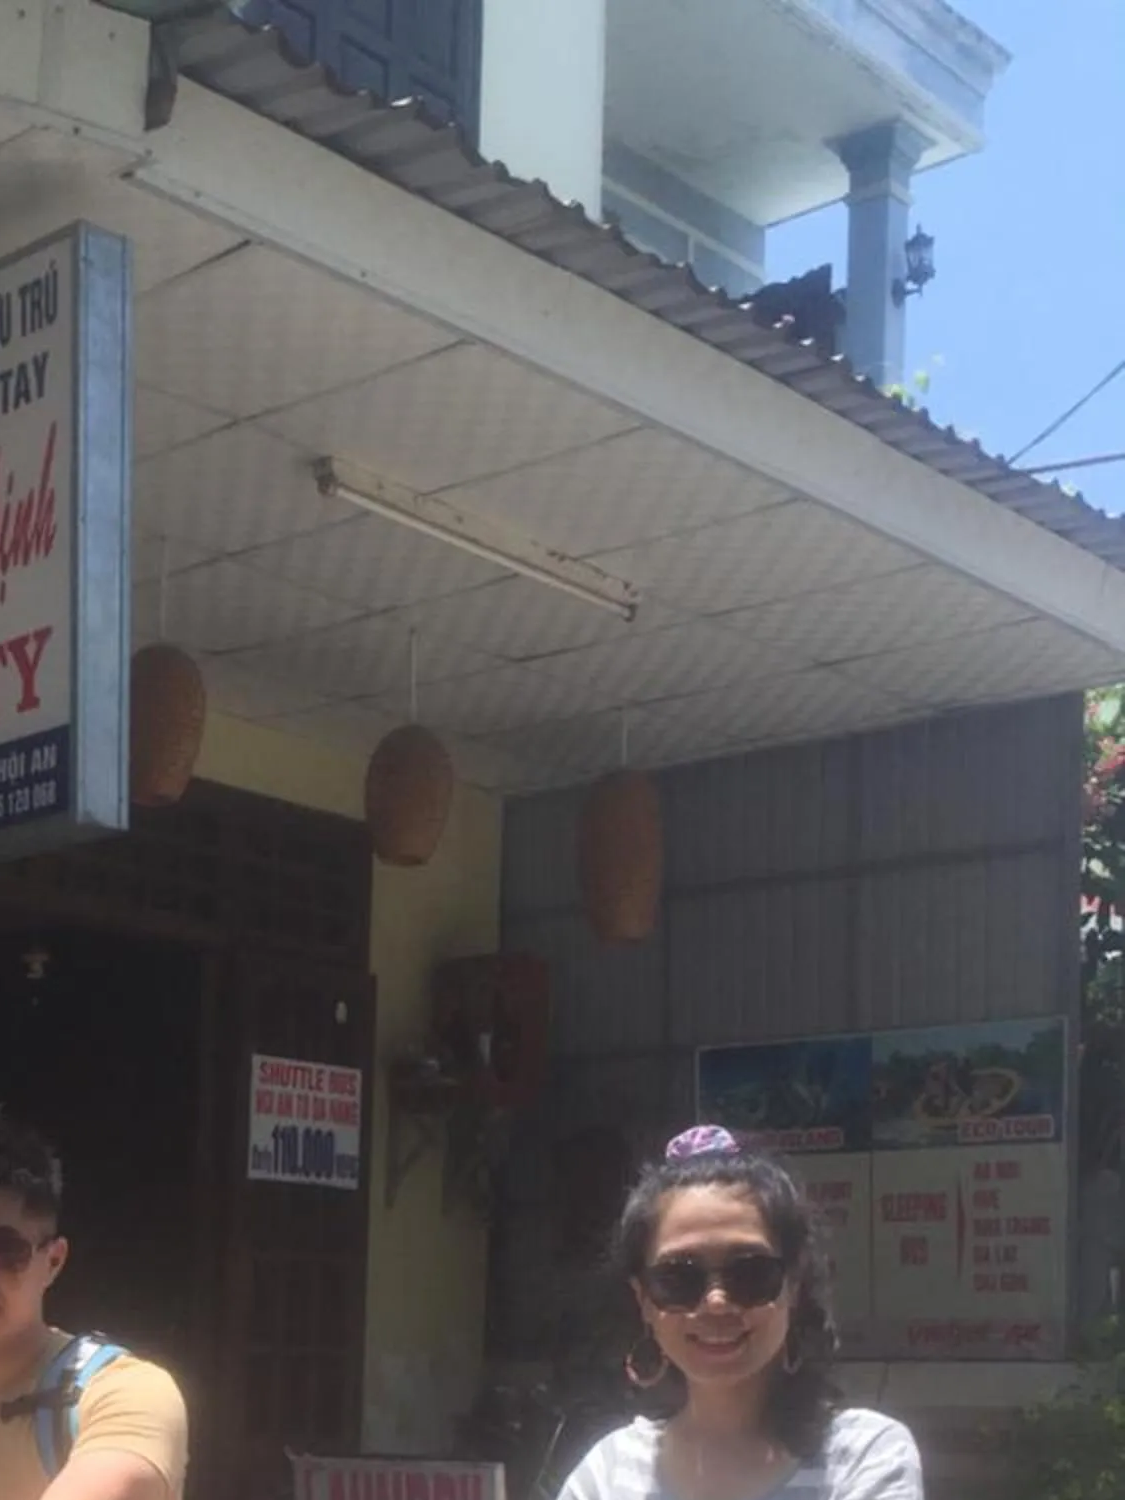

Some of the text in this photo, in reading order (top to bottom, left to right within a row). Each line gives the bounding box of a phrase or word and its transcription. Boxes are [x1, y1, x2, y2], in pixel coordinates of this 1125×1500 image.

[18, 259, 58, 337] TRÚ
[31, 744, 58, 774] AN
[259, 1061, 325, 1091] SHUTTLE
[961, 1118, 997, 1138] ECO
